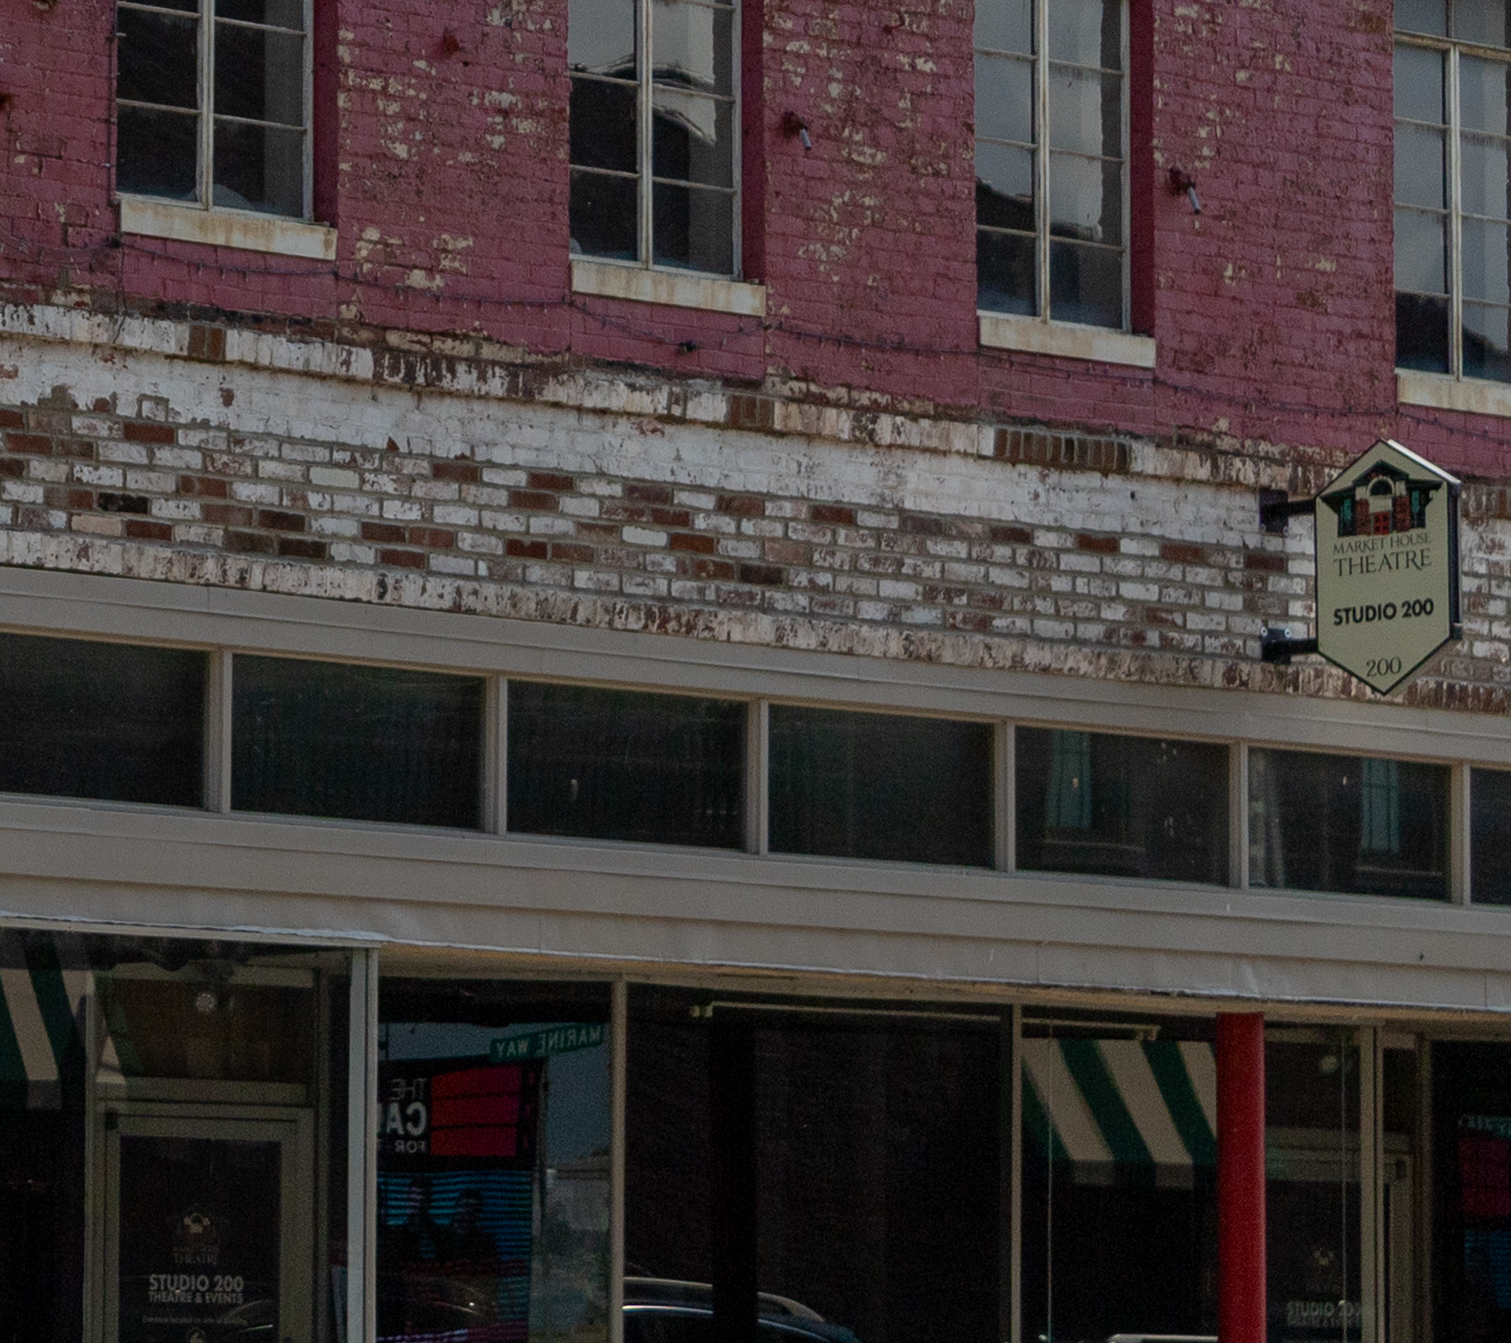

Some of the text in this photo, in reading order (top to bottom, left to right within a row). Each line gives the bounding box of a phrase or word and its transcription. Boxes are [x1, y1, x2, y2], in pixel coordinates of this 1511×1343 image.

[1333, 532, 1431, 555] MARKET HOUSE
[1333, 548, 1433, 577] THEATRE
[1333, 598, 1434, 626] STUDIO 200
[1366, 658, 1402, 678] 200
[148, 1273, 245, 1292] STUDIO 200
[148, 1291, 193, 1303] THEATRE
[205, 1292, 245, 1305] EVENTS
